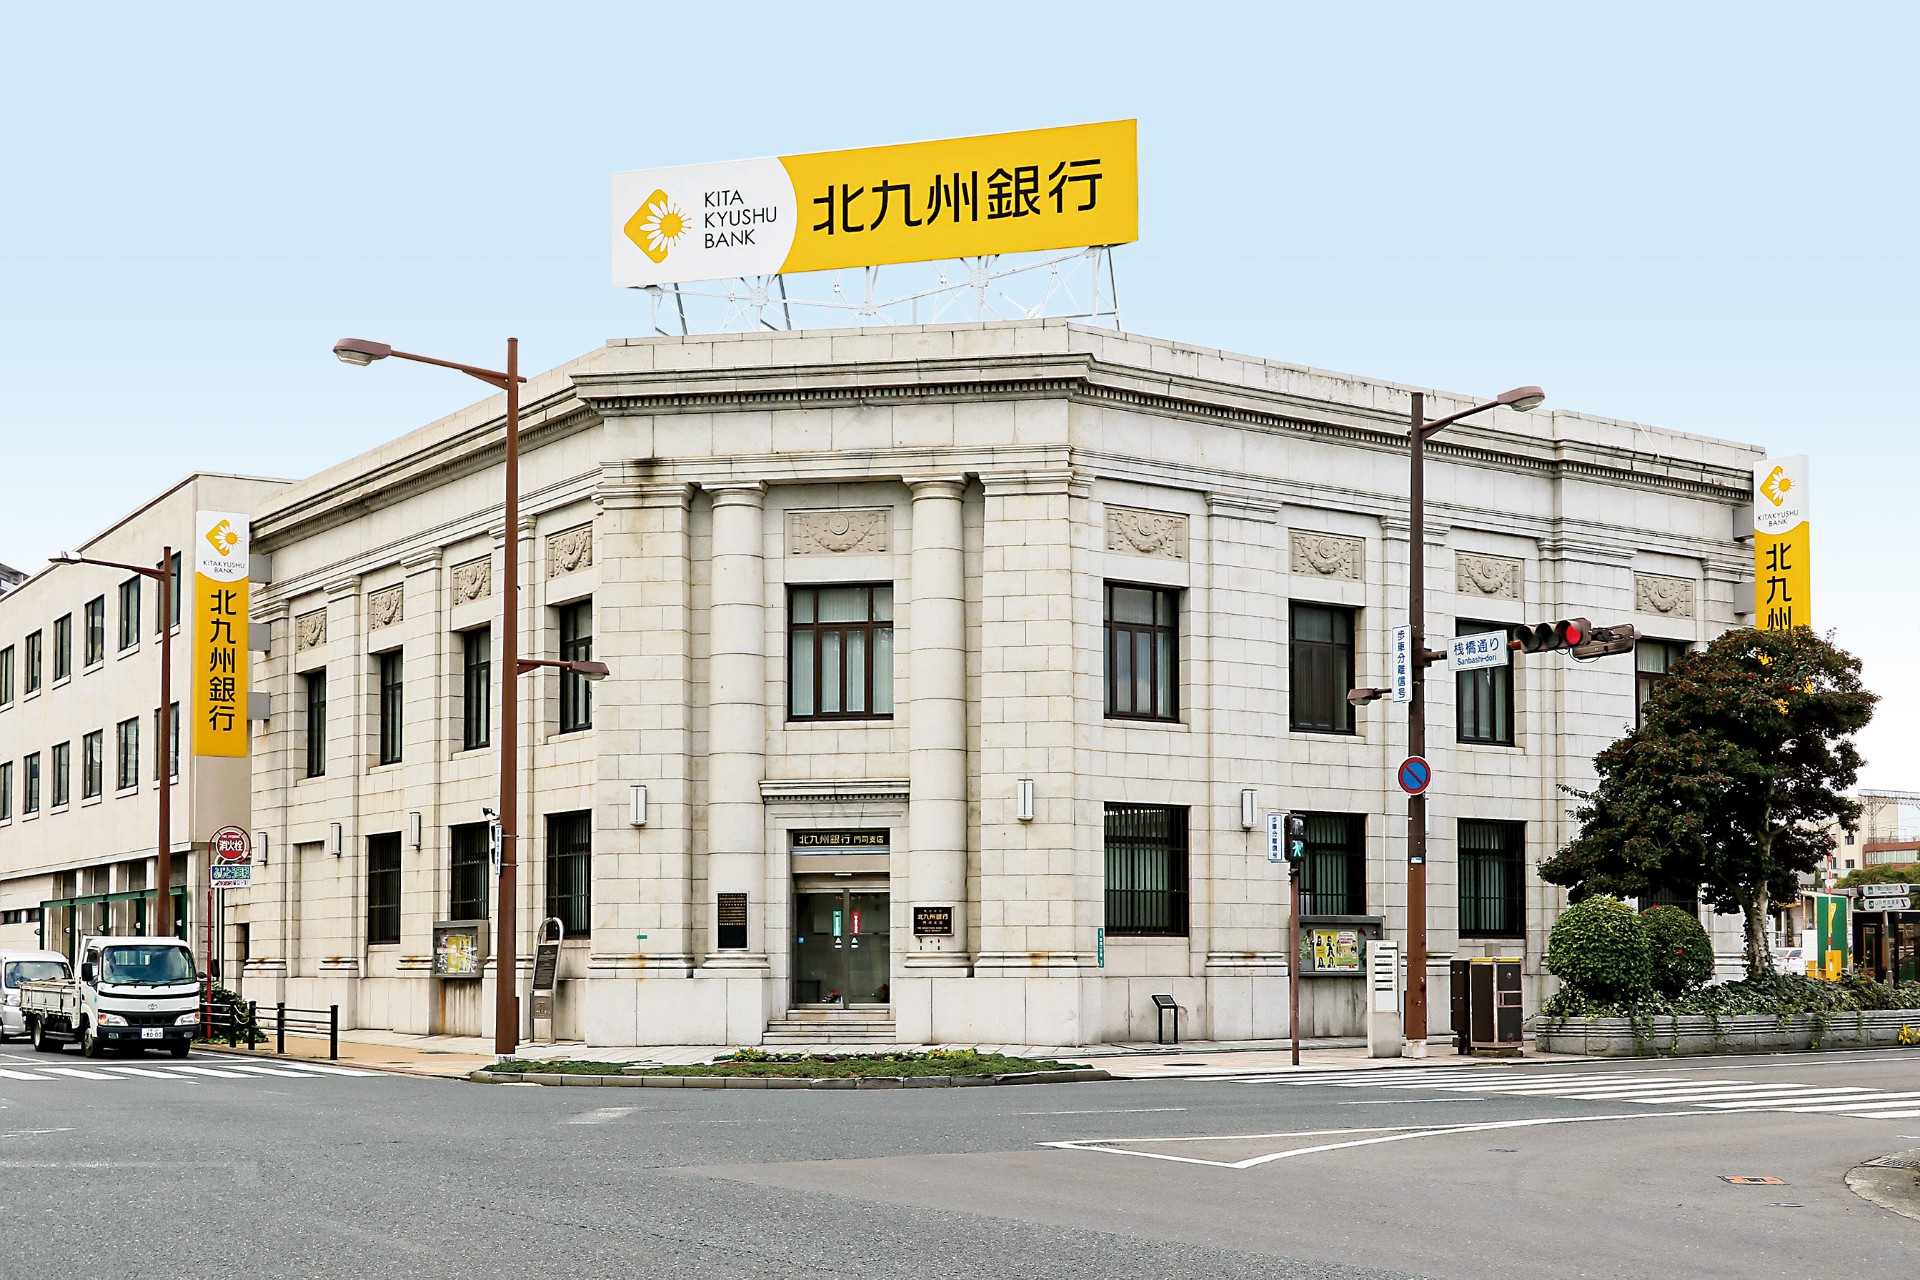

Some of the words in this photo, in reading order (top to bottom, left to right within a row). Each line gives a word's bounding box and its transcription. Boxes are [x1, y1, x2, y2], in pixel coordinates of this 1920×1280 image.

[704, 189, 744, 208] KITA
[813, 158, 1103, 236] 北九州銀行
[704, 206, 777, 229] KYUSHU
[704, 228, 756, 249] BANK
[1757, 509, 1800, 521] KITAKYUSHU
[1768, 518, 1788, 527] BANK
[202, 560, 246, 569] KITAKYUSHU
[213, 567, 234, 575] BANK
[1453, 637, 1499, 656] 桟橋通り
[209, 589, 237, 732] 北九州銀行
[1397, 630, 1406, 699] 歩車分離信号
[1457, 653, 1497, 666] Sanbashi-dori
[218, 840, 244, 852] 消火栓
[799, 834, 851, 845] 北九州銀行
